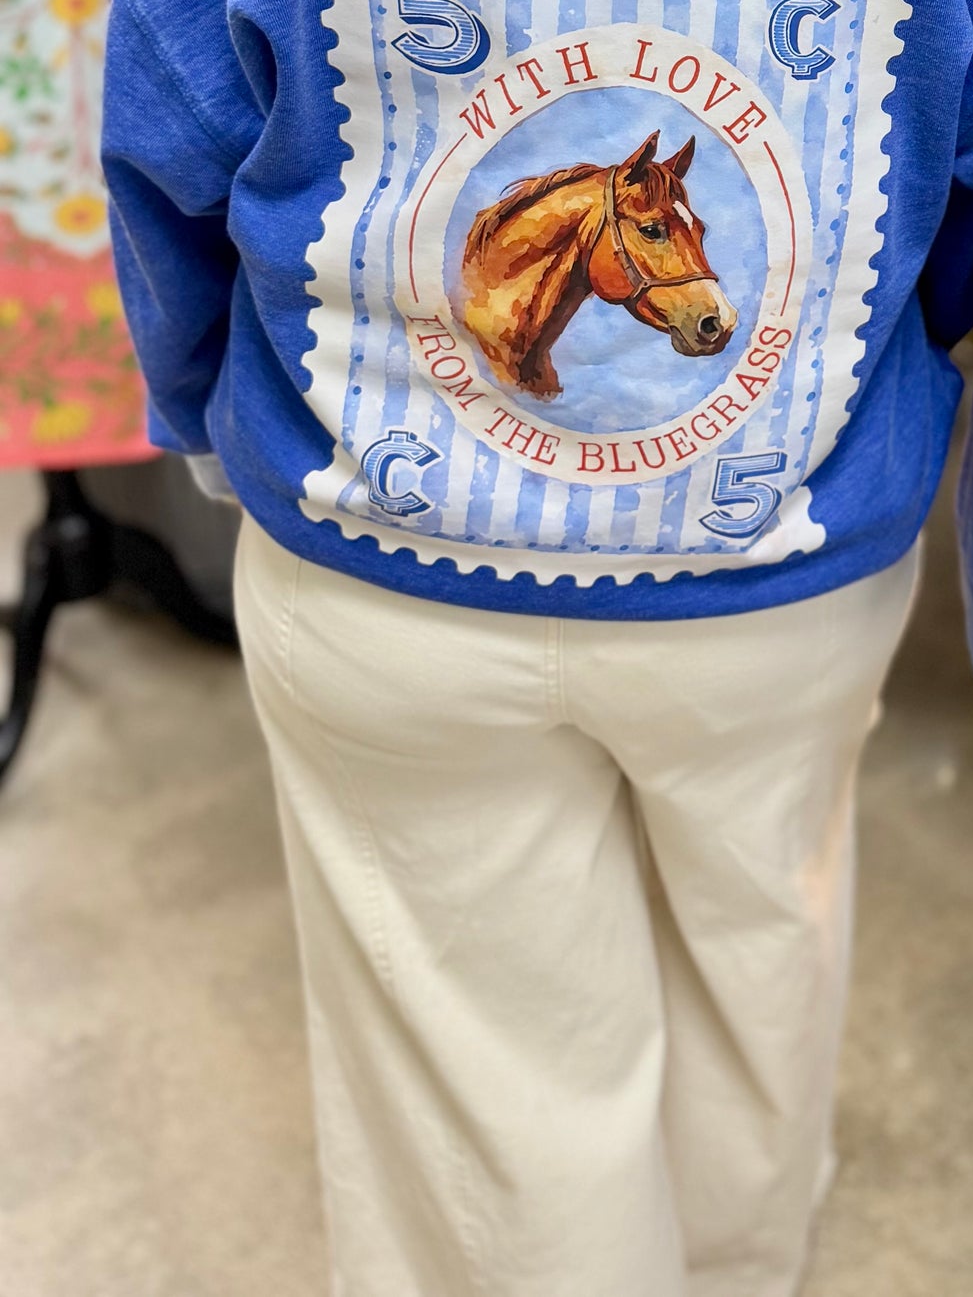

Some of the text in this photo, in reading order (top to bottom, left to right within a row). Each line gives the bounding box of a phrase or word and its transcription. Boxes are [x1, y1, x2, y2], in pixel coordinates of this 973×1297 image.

[458, 39, 767, 144] WITH LOVE
[407, 313, 794, 473] FROM THE BLUEGRASS
